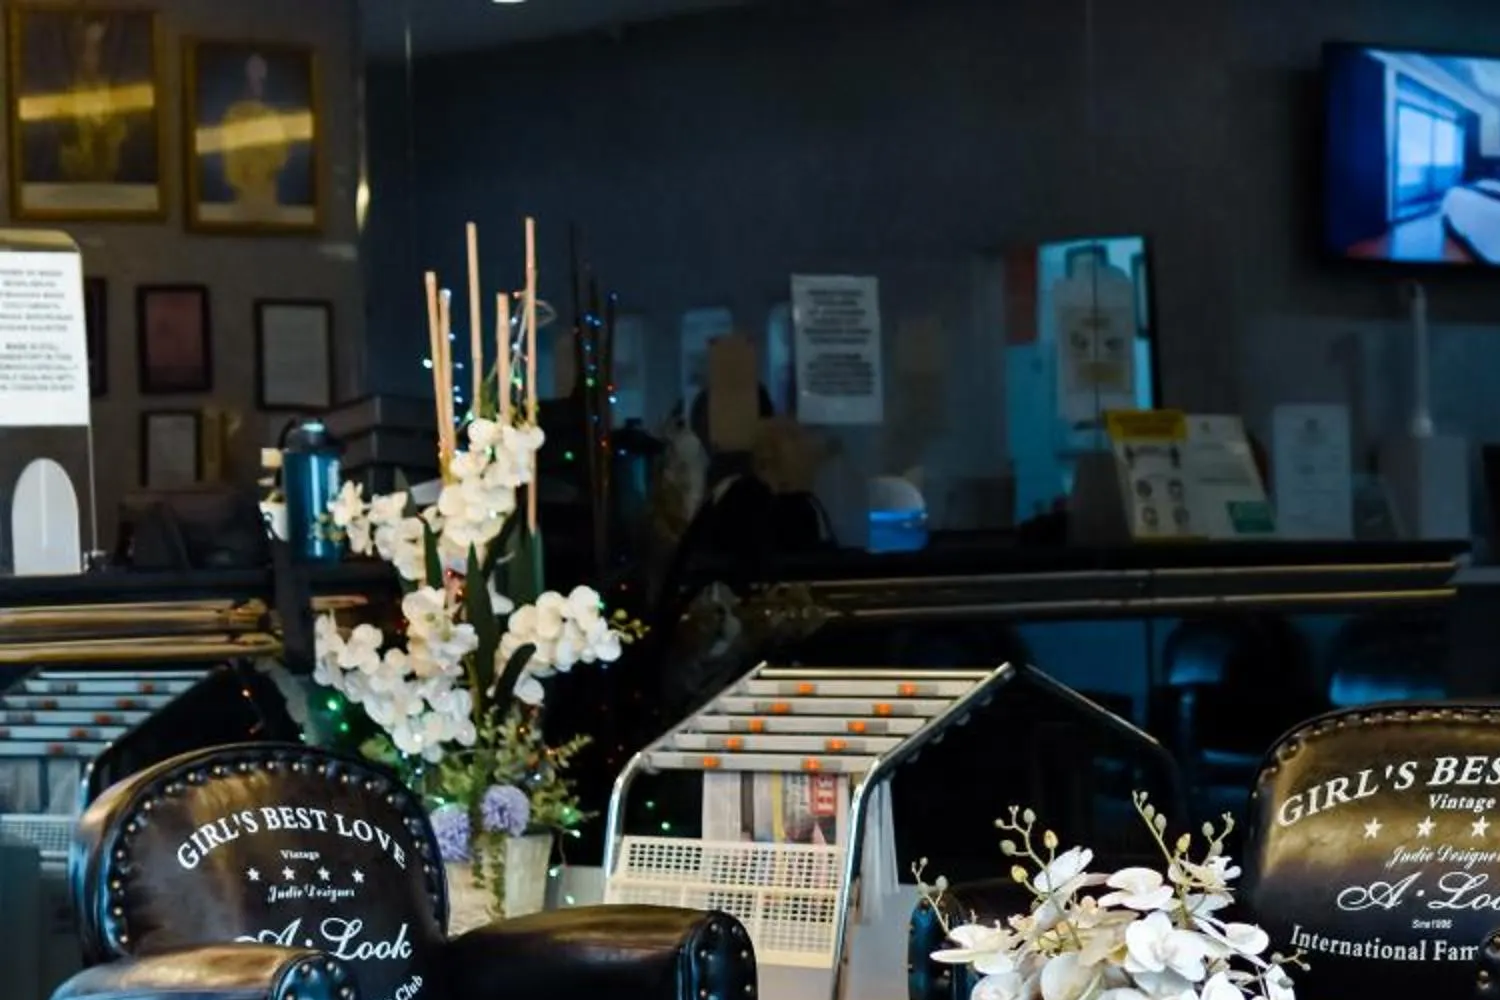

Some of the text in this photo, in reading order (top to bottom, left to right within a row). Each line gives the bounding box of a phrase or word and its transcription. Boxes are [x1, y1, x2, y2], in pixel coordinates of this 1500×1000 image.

[1277, 761, 1417, 827] GIRL'S
[1429, 794, 1496, 812] Vintage
[177, 807, 406, 870] GIRL'S BEST LOVE
[1289, 925, 1480, 961] International Fam
